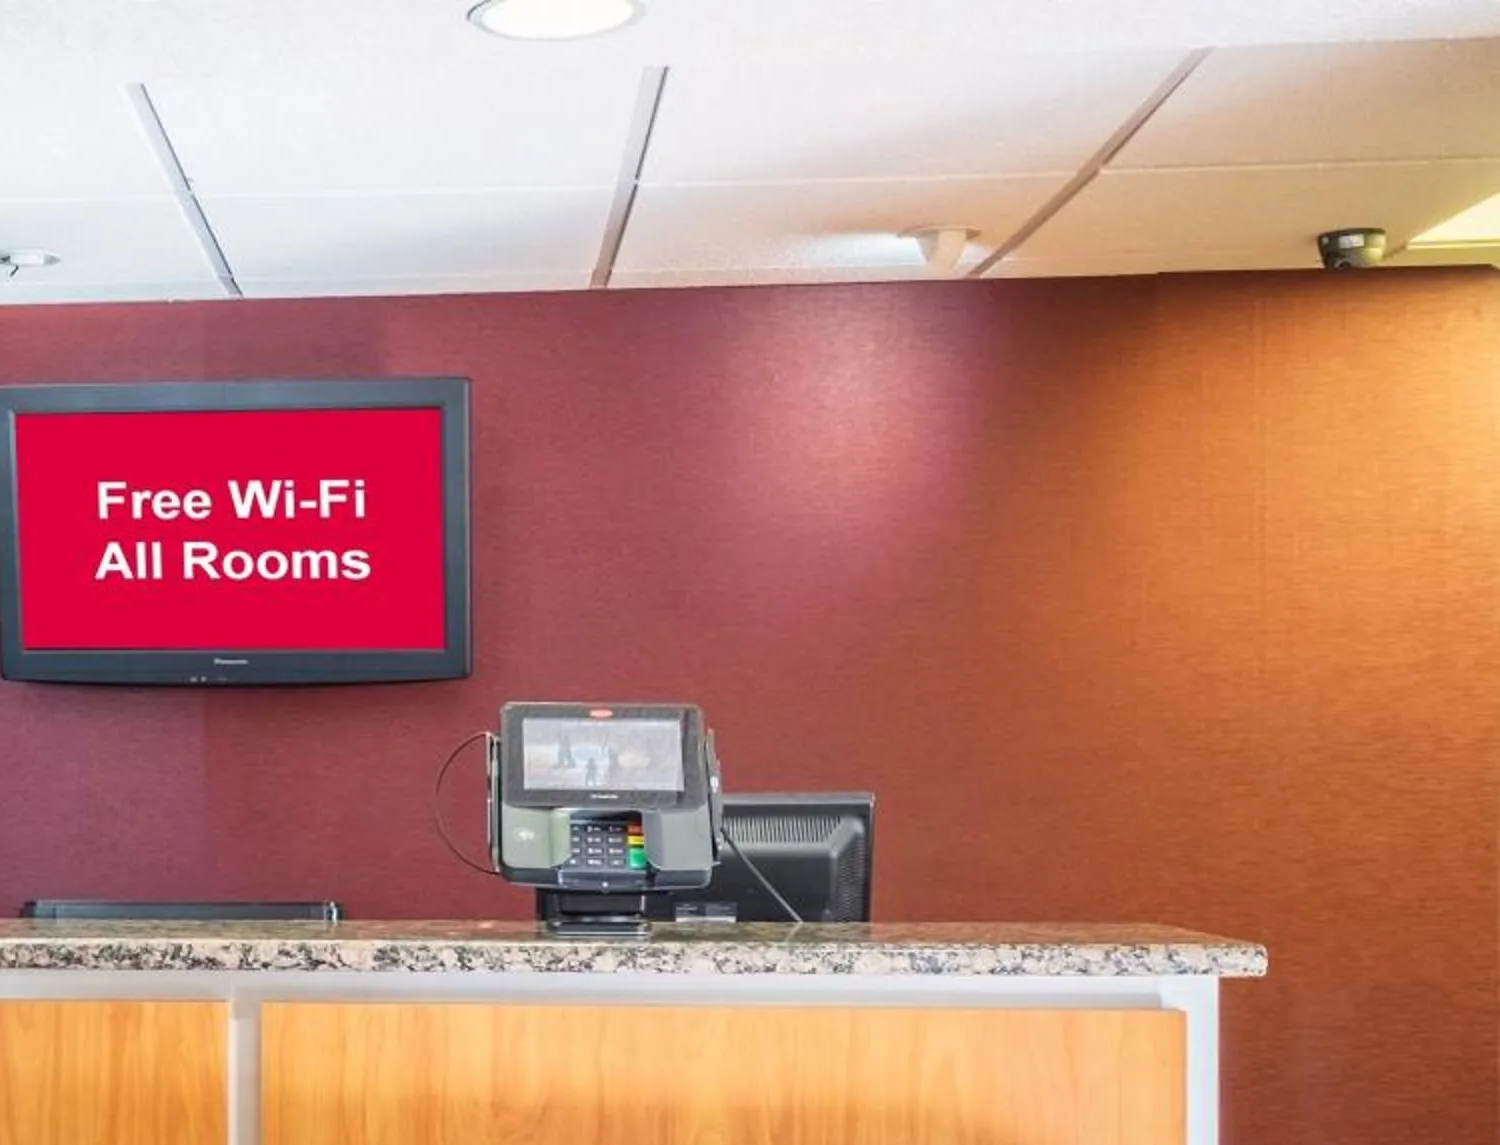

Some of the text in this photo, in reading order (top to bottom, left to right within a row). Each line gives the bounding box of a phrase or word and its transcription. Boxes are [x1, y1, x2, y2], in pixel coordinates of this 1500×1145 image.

[97, 480, 365, 519] Free Wi-Fi
[95, 541, 371, 579] All Rooms
